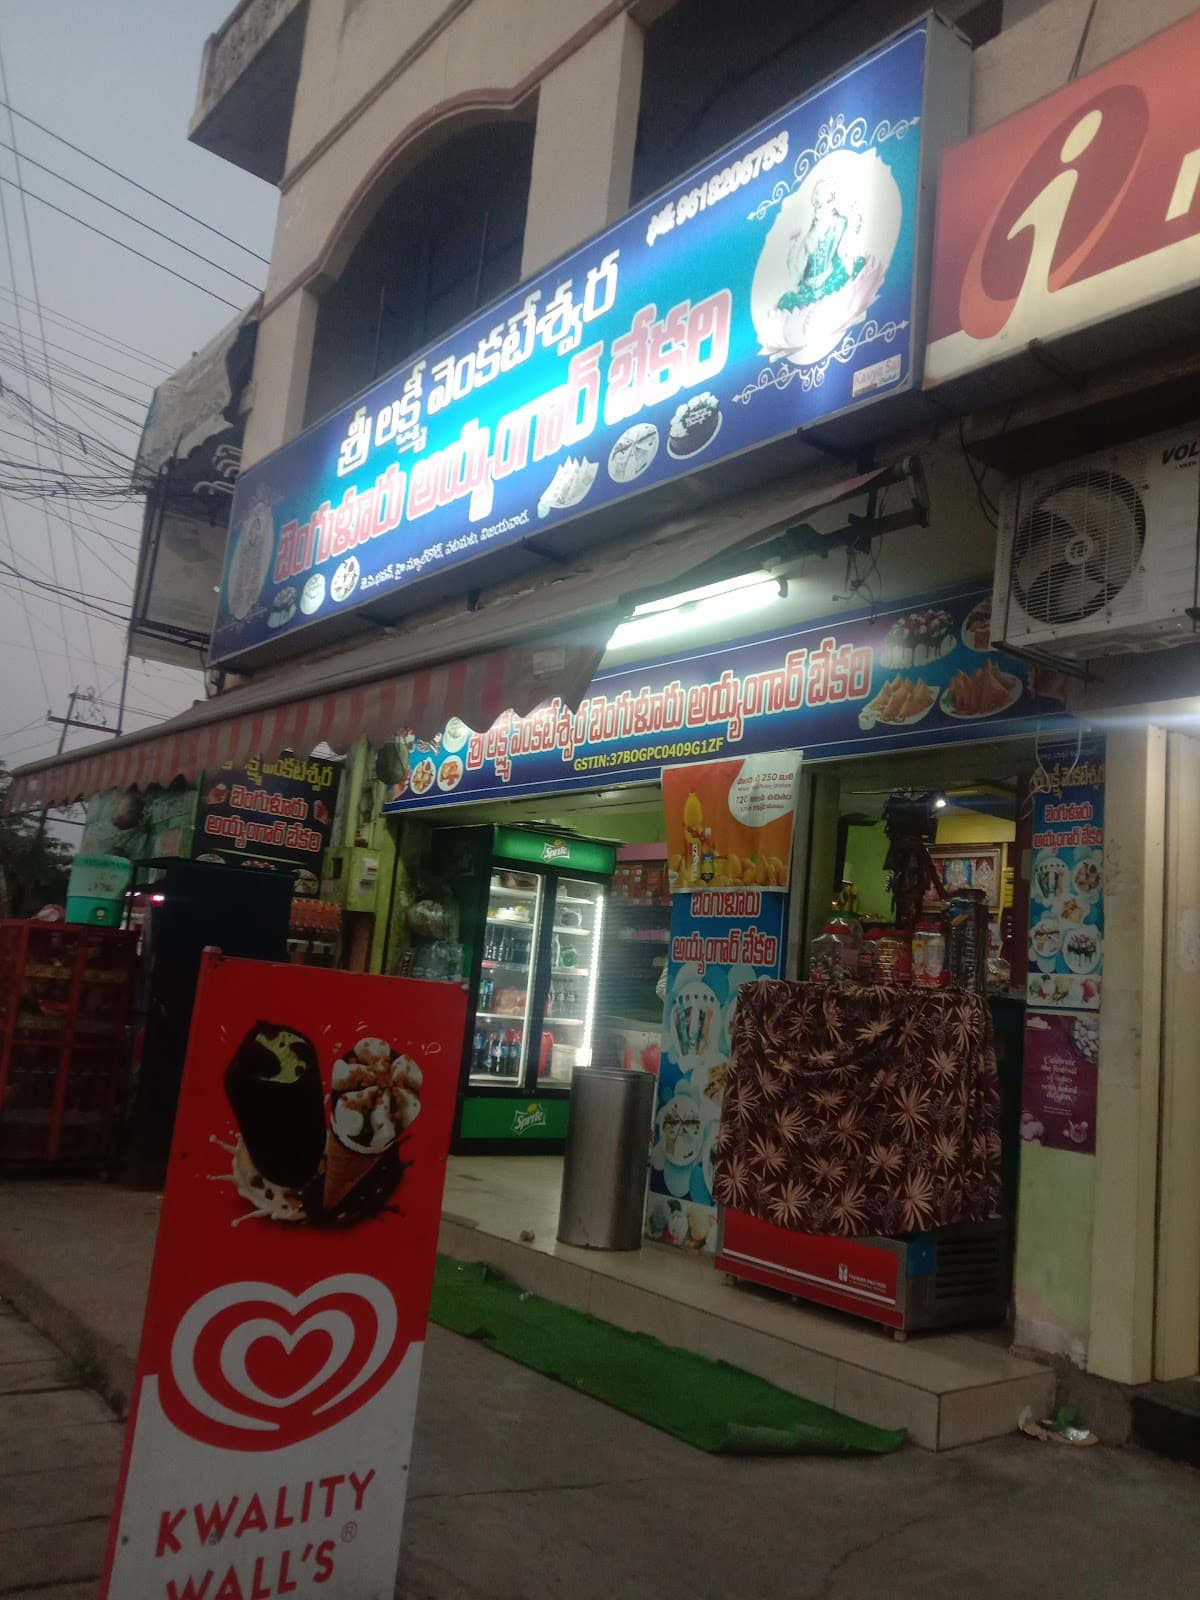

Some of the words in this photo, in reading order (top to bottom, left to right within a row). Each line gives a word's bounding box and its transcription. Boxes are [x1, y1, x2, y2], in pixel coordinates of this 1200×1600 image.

[337, 406, 372, 477] శ్రీ
[375, 360, 428, 453] లక్ష్మీ
[427, 249, 620, 415] వెంకటేశ్వర
[589, 681, 686, 742] బెంగుళూరు
[686, 648, 808, 743] అయ్యంగార్
[205, 815, 286, 848] అయ్యంగార్
[544, 846, 568, 860] Sprite
[672, 927, 742, 976] అయ్యంగార్
[514, 1111, 545, 1130] Sprite
[155, 1469, 376, 1558] KWALITY
